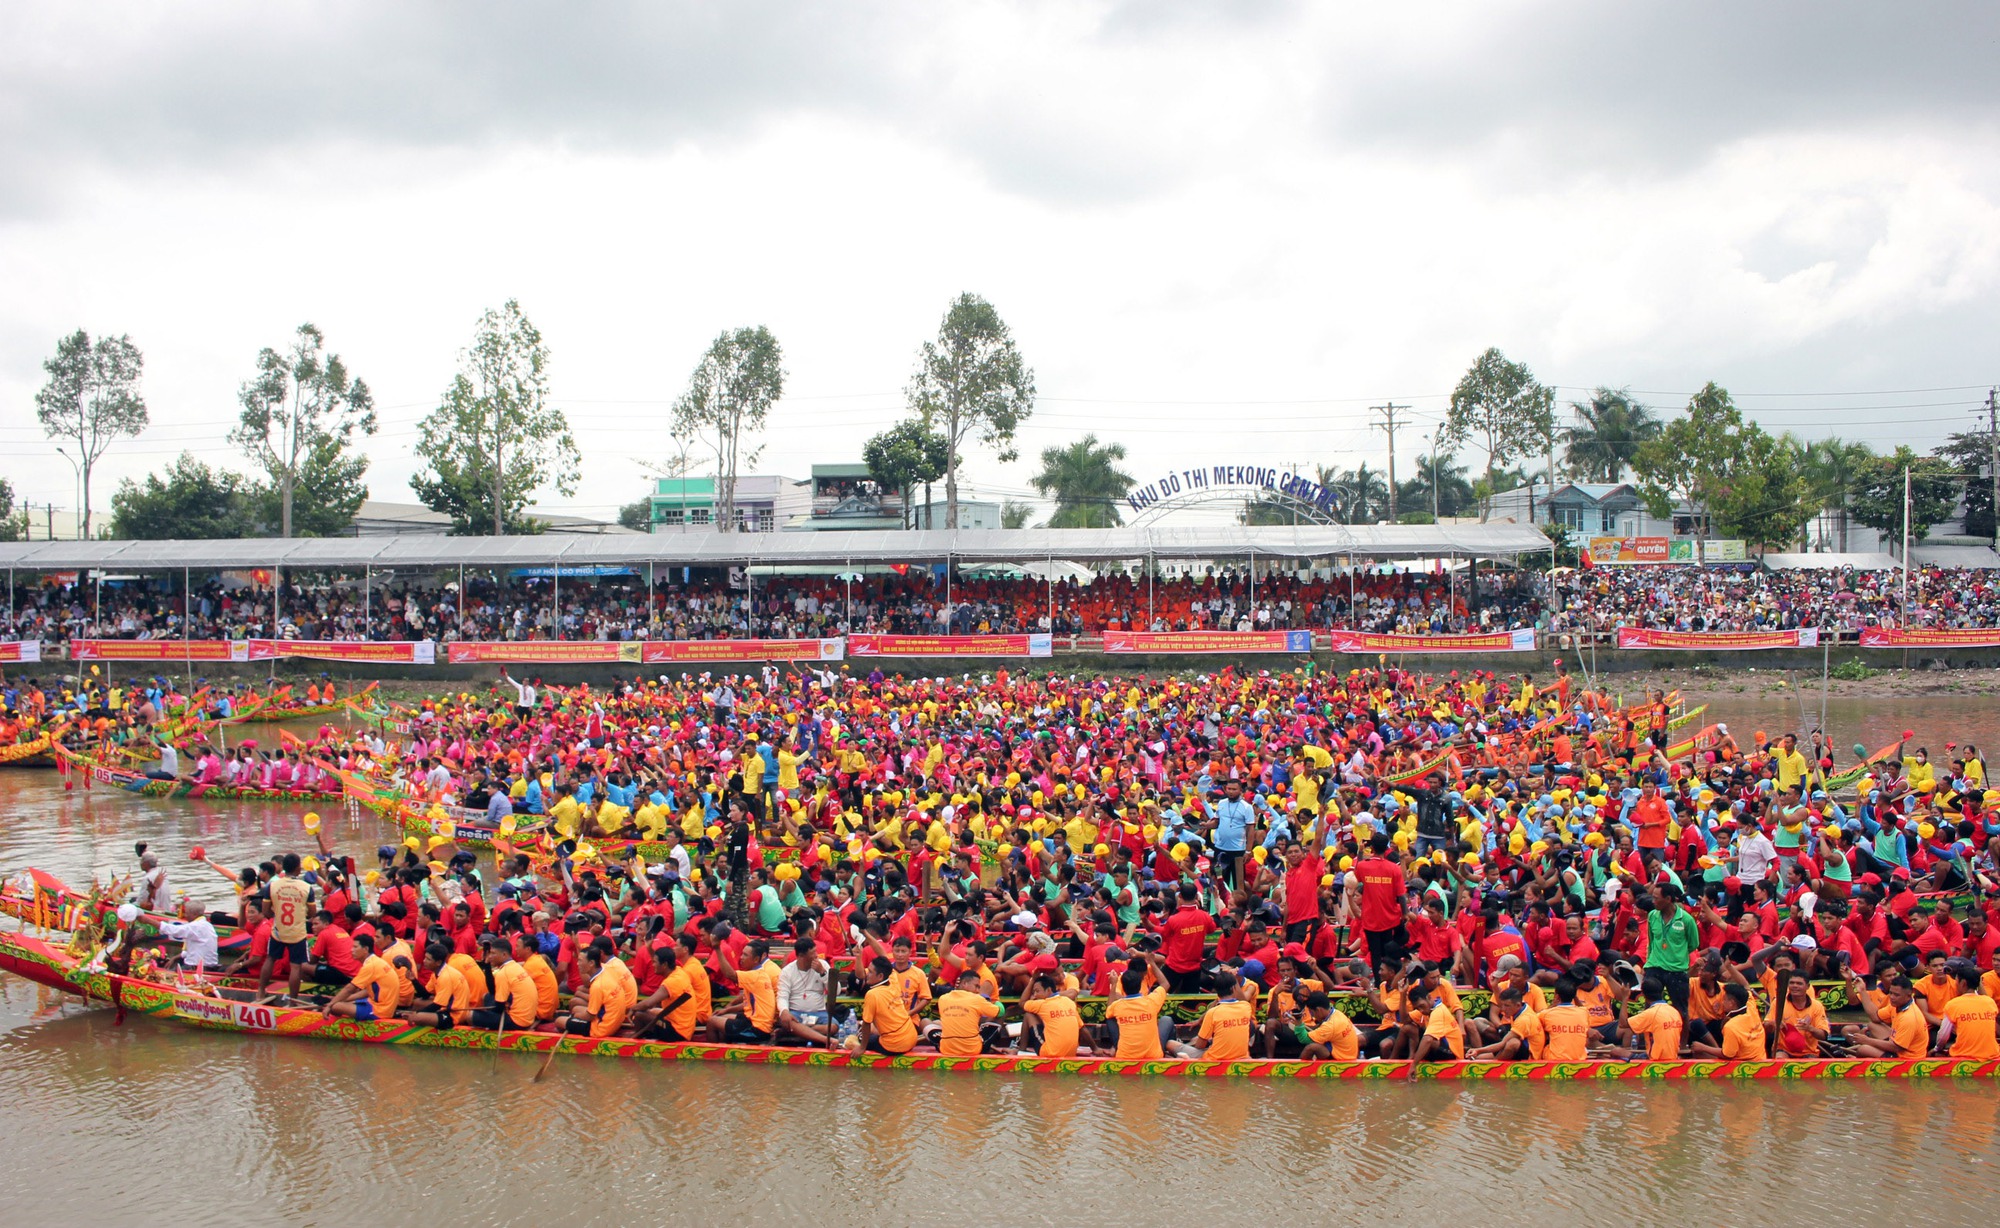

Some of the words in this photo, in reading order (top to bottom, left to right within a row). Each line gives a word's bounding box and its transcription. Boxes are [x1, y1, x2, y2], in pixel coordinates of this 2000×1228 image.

[1127, 484, 1158, 512] KHU
[1159, 470, 1180, 497] ĐÔ
[1183, 468, 1208, 489] THỊ
[1214, 466, 1276, 489] MEKONG
[1280, 472, 1338, 513] CENTRE
[1637, 542, 1665, 554] QUYÊN
[96, 769, 109, 780] 05
[281, 902, 295, 926] 8
[240, 1006, 272, 1028] 40
[1050, 1009, 1064, 1018] BẠC
[1119, 1016, 1133, 1024] BẠC
[1135, 1013, 1152, 1023] LIÊU
[1960, 1013, 1977, 1022] BẠC
[1223, 1019, 1236, 1028] BẠC
[1552, 1024, 1567, 1034] BẠC
[1569, 1024, 1585, 1034] LIÊU
